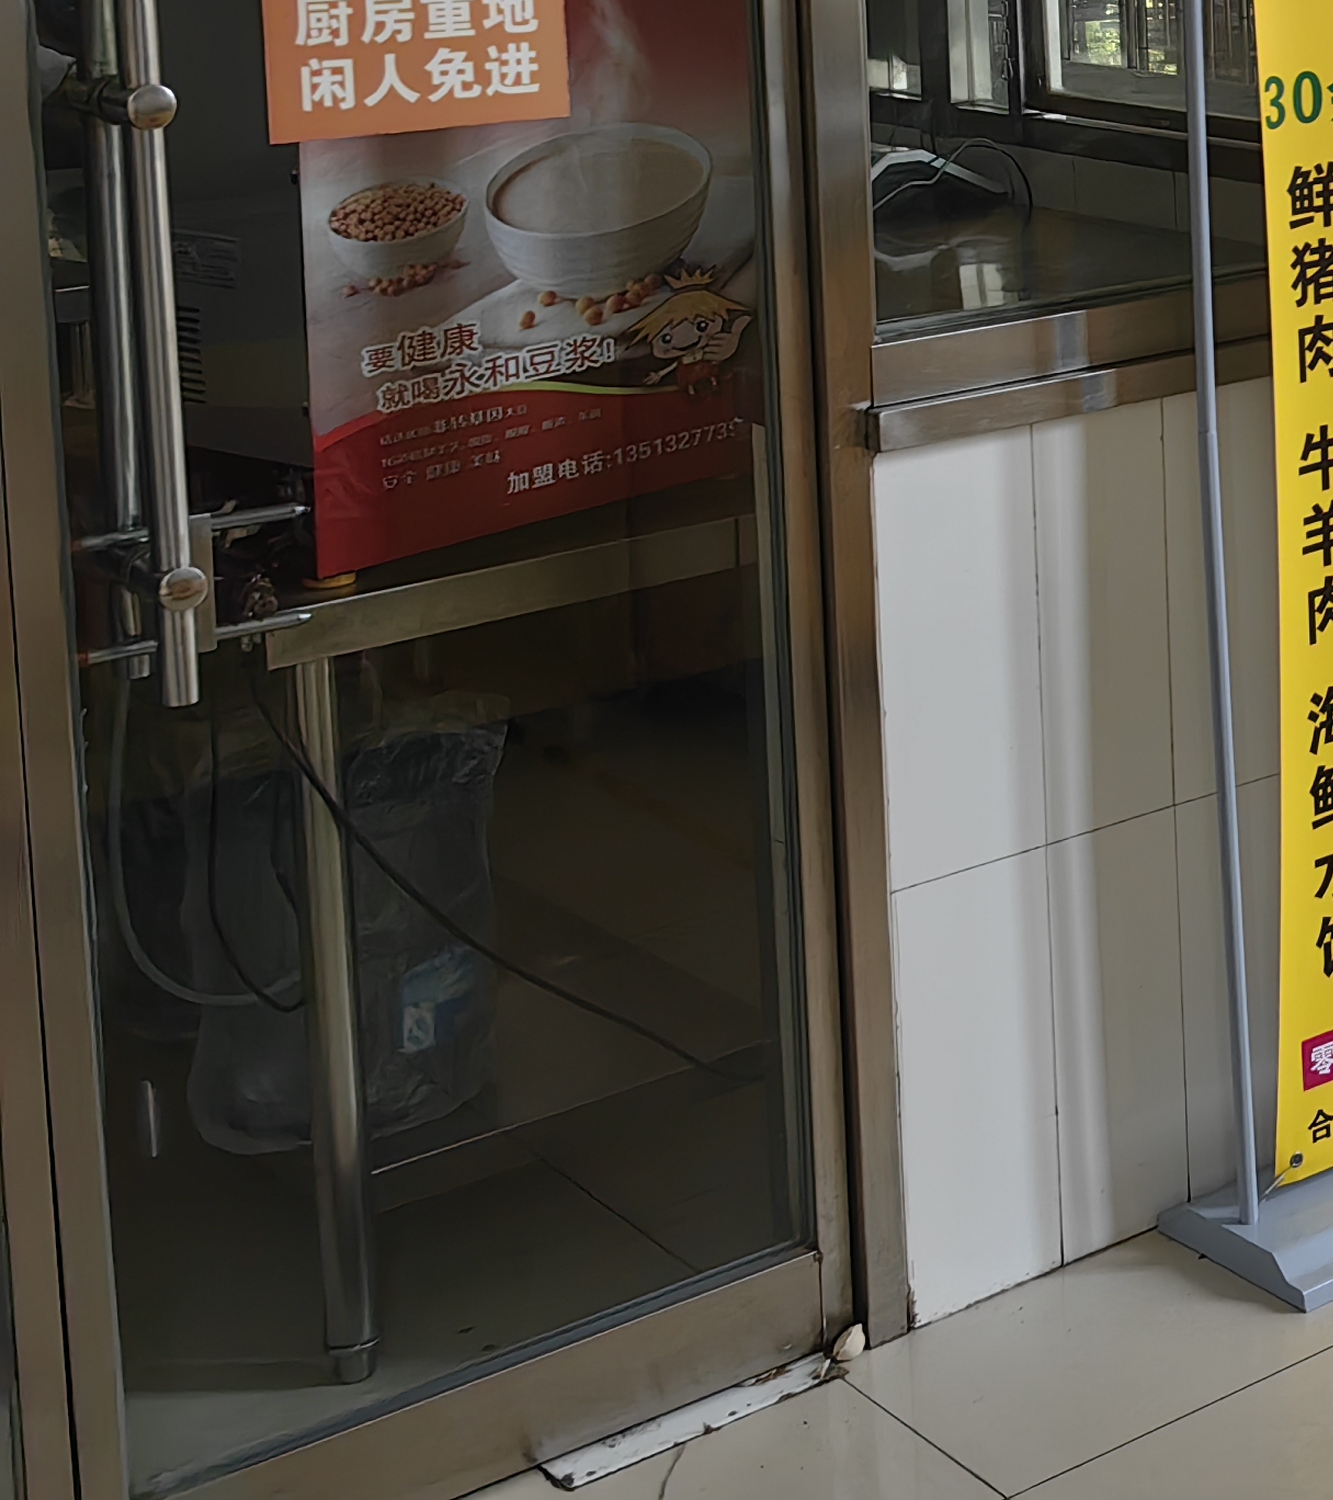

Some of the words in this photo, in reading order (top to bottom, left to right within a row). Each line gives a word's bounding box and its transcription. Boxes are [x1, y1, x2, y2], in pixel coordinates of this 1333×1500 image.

[301, 45, 540, 111] 闲人免进
[362, 321, 480, 376] 要健康
